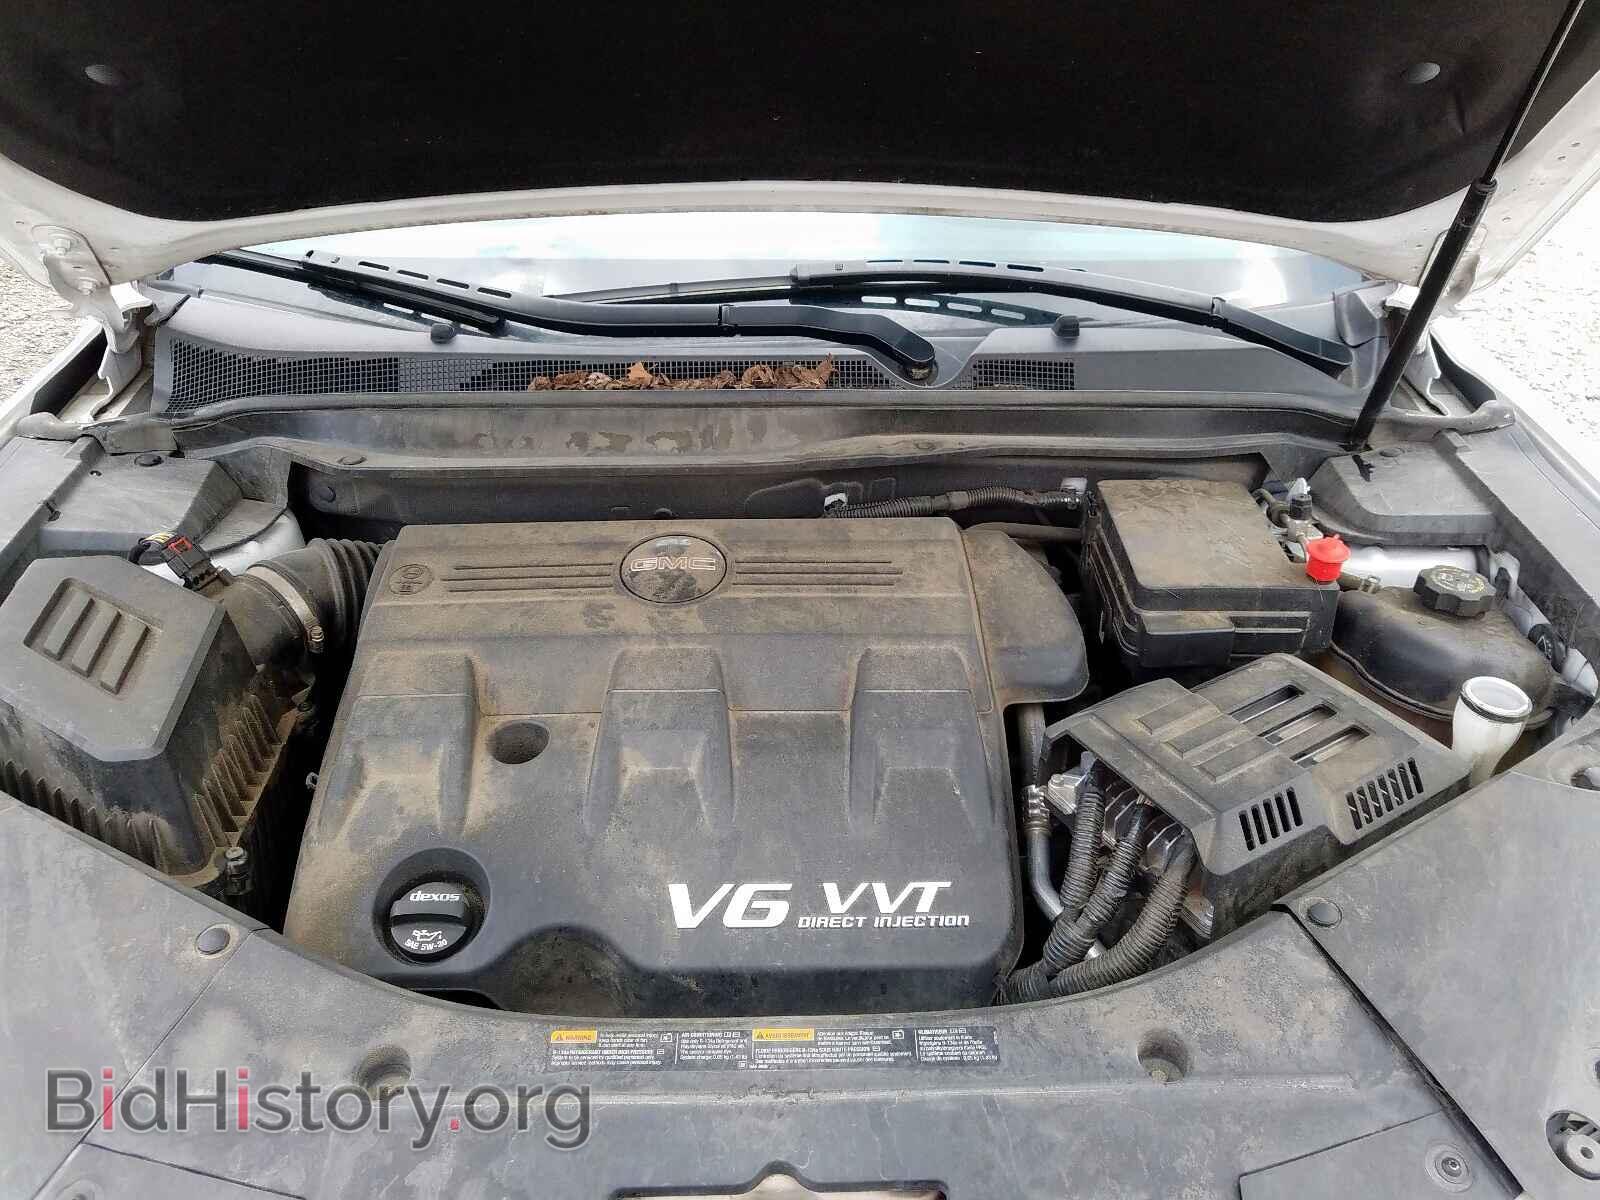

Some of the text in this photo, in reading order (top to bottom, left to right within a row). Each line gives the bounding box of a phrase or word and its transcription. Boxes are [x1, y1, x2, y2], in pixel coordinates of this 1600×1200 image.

[631, 557, 717, 572] GMC
[409, 890, 462, 903] dexos
[668, 881, 952, 929] V6 VVT
[797, 915, 970, 929] DIRECT INJECTION
